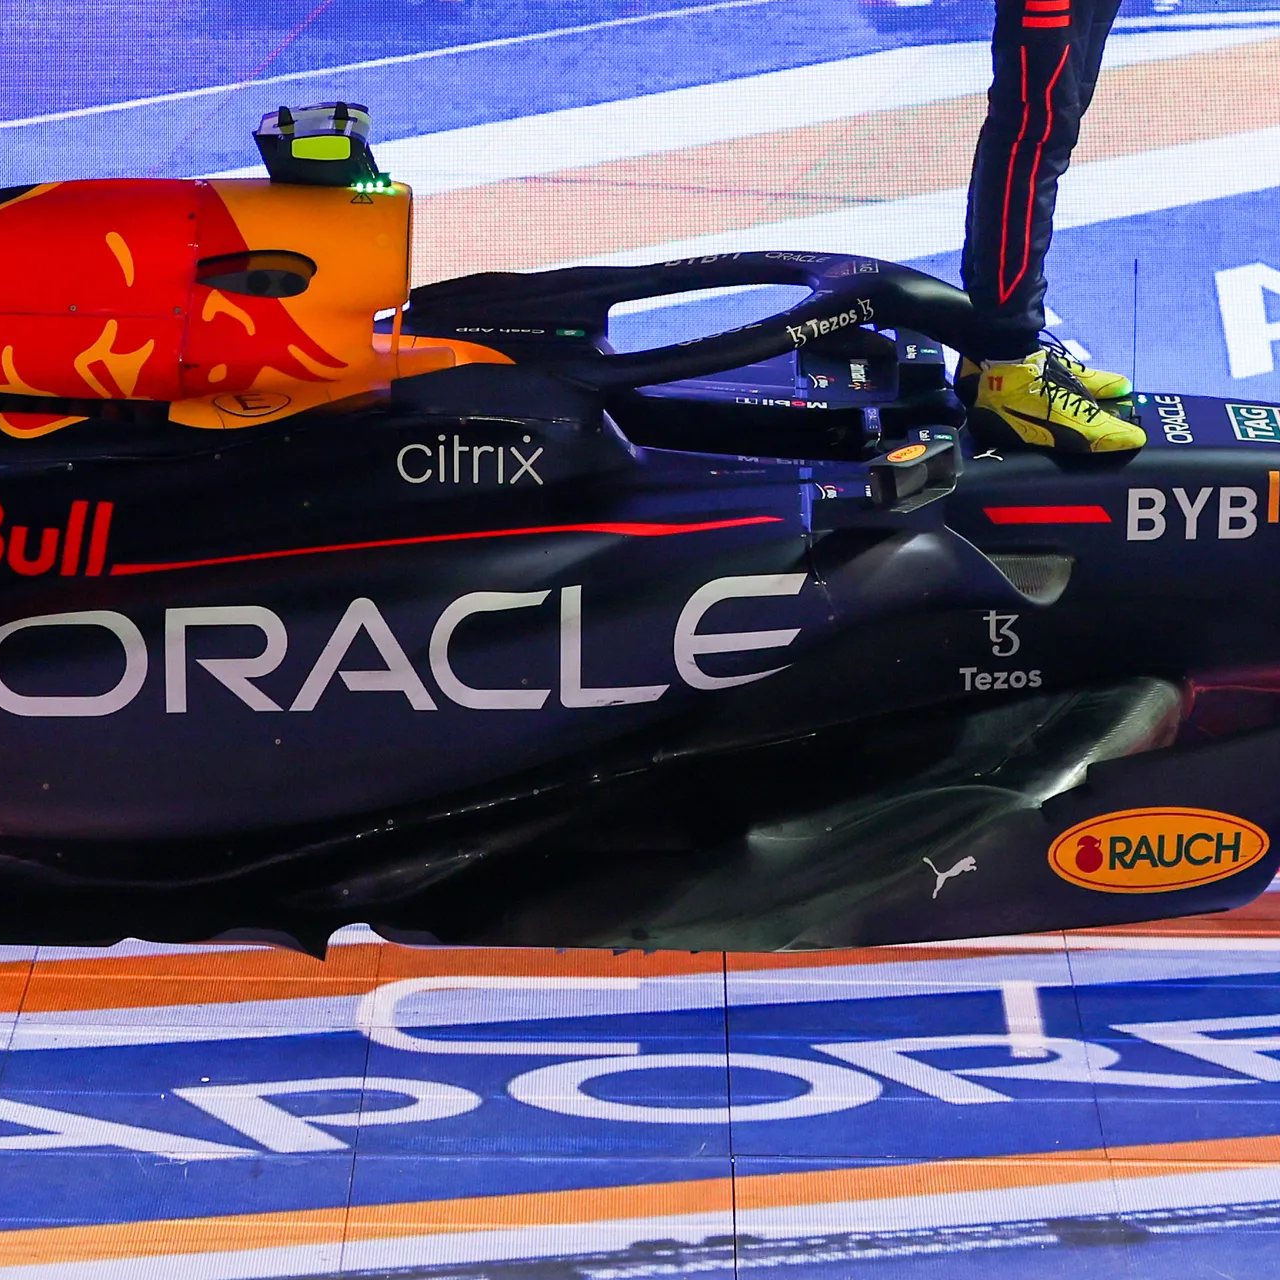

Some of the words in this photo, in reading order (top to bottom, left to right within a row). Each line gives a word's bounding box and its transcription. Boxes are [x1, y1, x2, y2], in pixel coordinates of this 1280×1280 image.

[805, 308, 859, 338] Tezos
[987, 376, 1004, 391] 11
[1153, 394, 1195, 445] ORACLE
[1245, 406, 1273, 439] TAG
[397, 433, 544, 486] citrix
[959, 666, 1043, 692] Tezos
[1108, 831, 1243, 871] RAUCH
